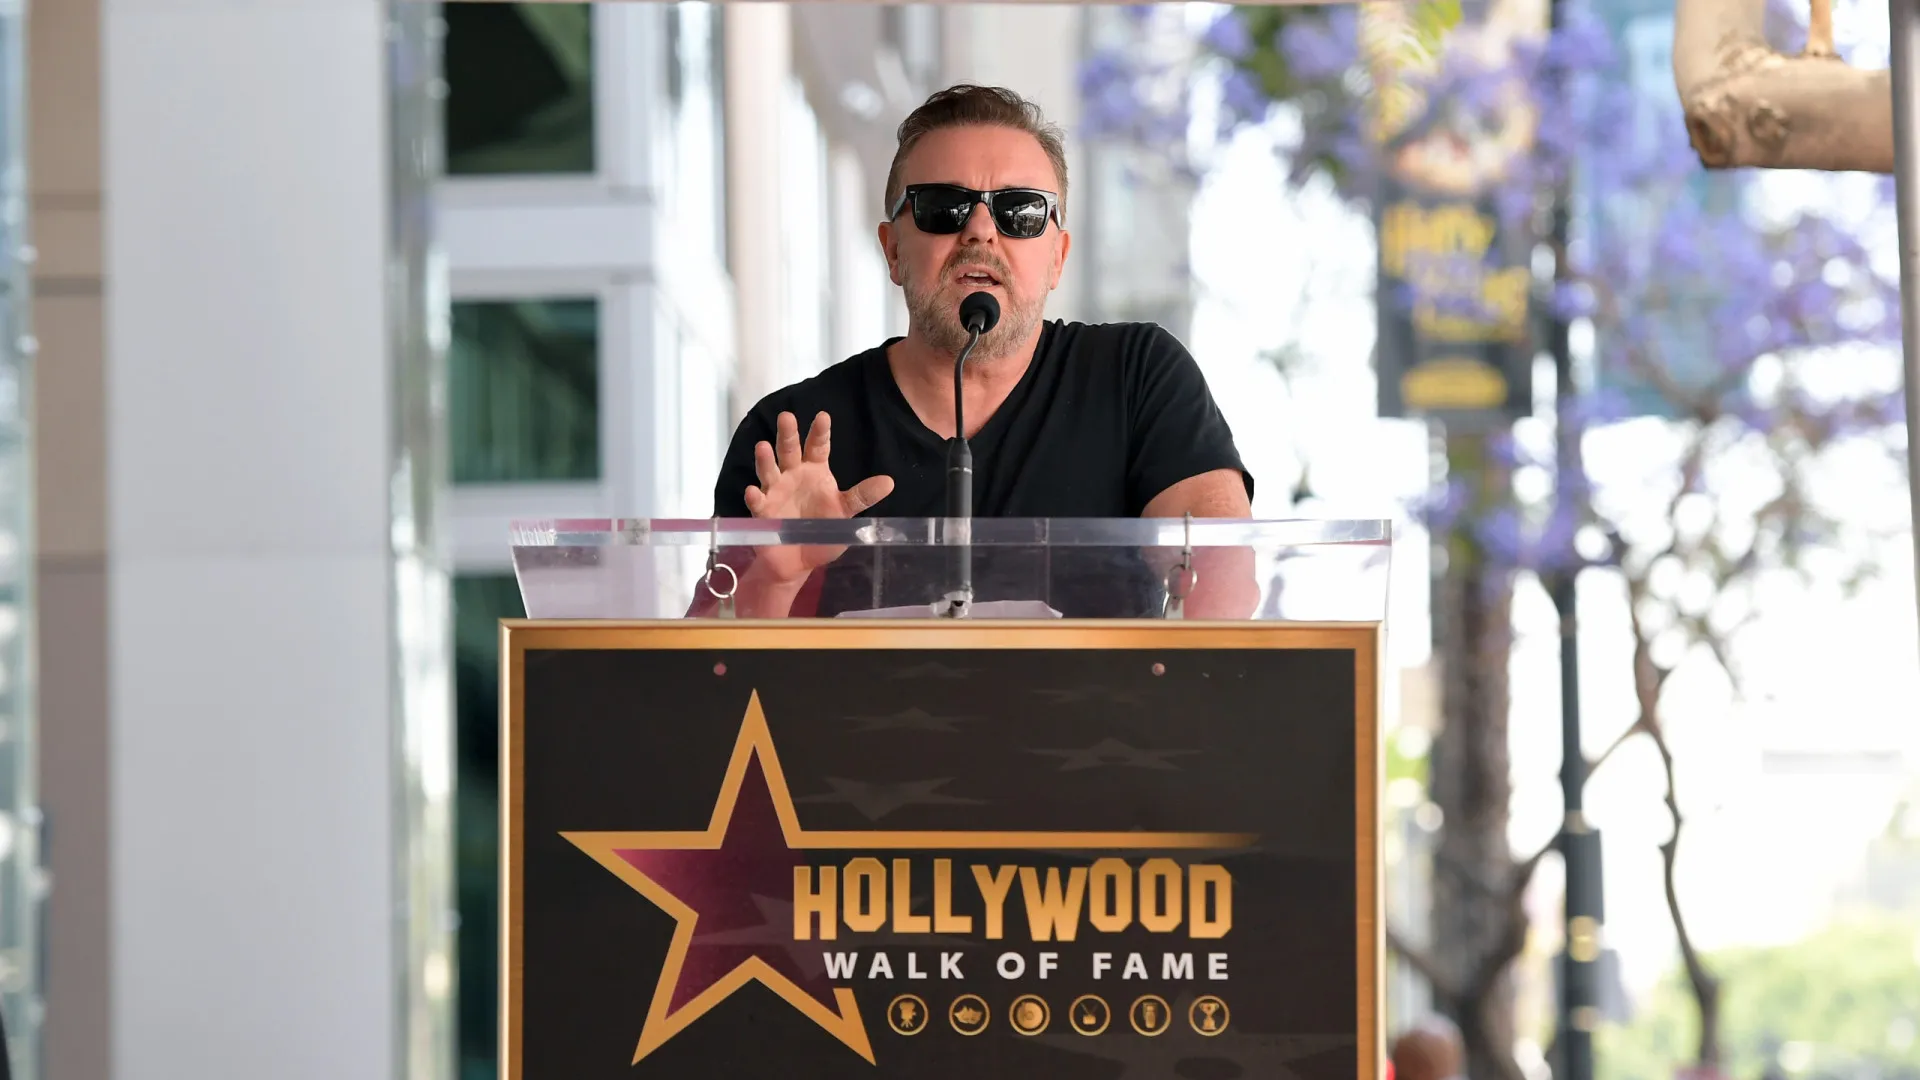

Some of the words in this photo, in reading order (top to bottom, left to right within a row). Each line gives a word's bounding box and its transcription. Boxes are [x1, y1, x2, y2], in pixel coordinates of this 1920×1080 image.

[793, 857, 1232, 942] HOLLYWOOD
[823, 951, 964, 980] WALK
[996, 951, 1058, 980] OF
[1093, 952, 1229, 980] FAME
